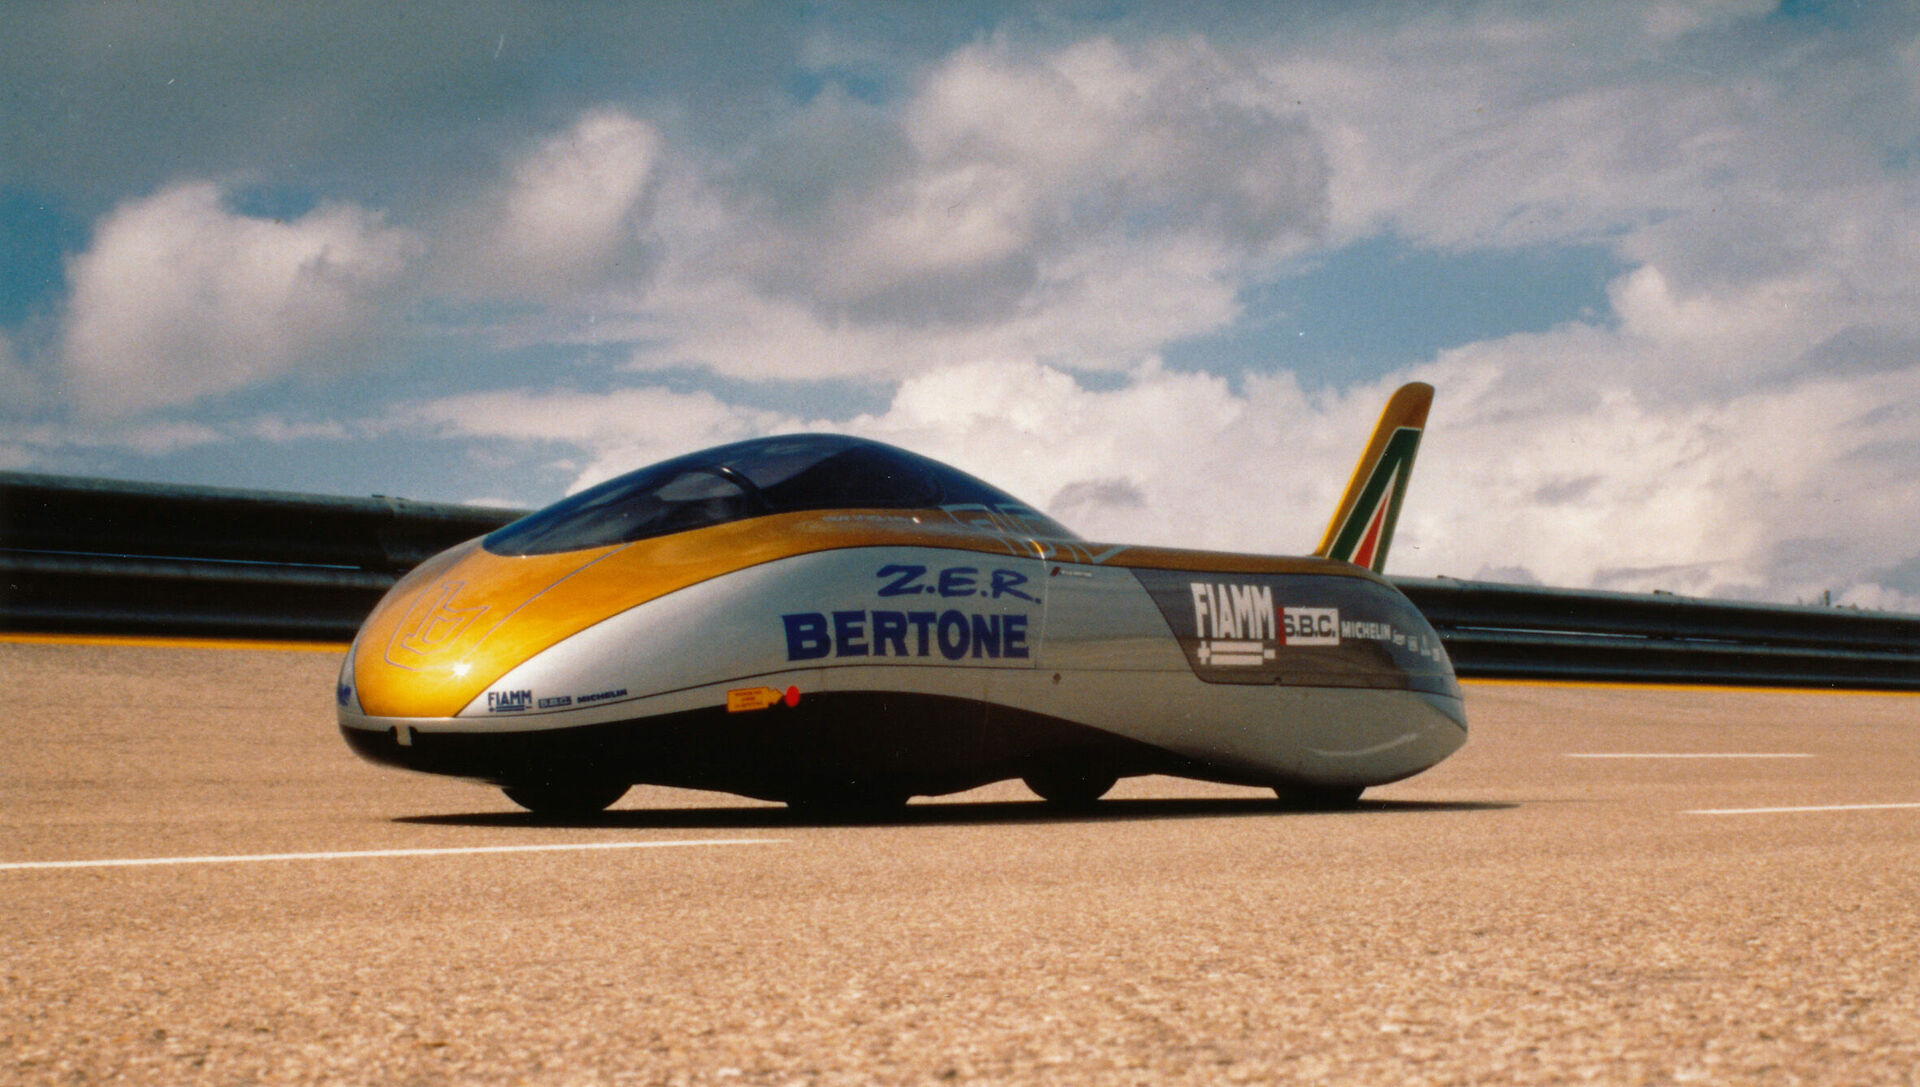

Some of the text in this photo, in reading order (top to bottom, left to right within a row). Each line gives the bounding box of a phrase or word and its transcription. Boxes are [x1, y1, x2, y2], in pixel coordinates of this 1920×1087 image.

[876, 564, 1042, 604] Z.E.R.
[1190, 583, 1276, 639] FIAMM
[782, 610, 1029, 661] BERTONE
[1284, 614, 1336, 637] S.B.C.
[1341, 621, 1391, 640] MICHELIN
[488, 690, 532, 706] FIAMM
[577, 689, 627, 703] MICHELIN
